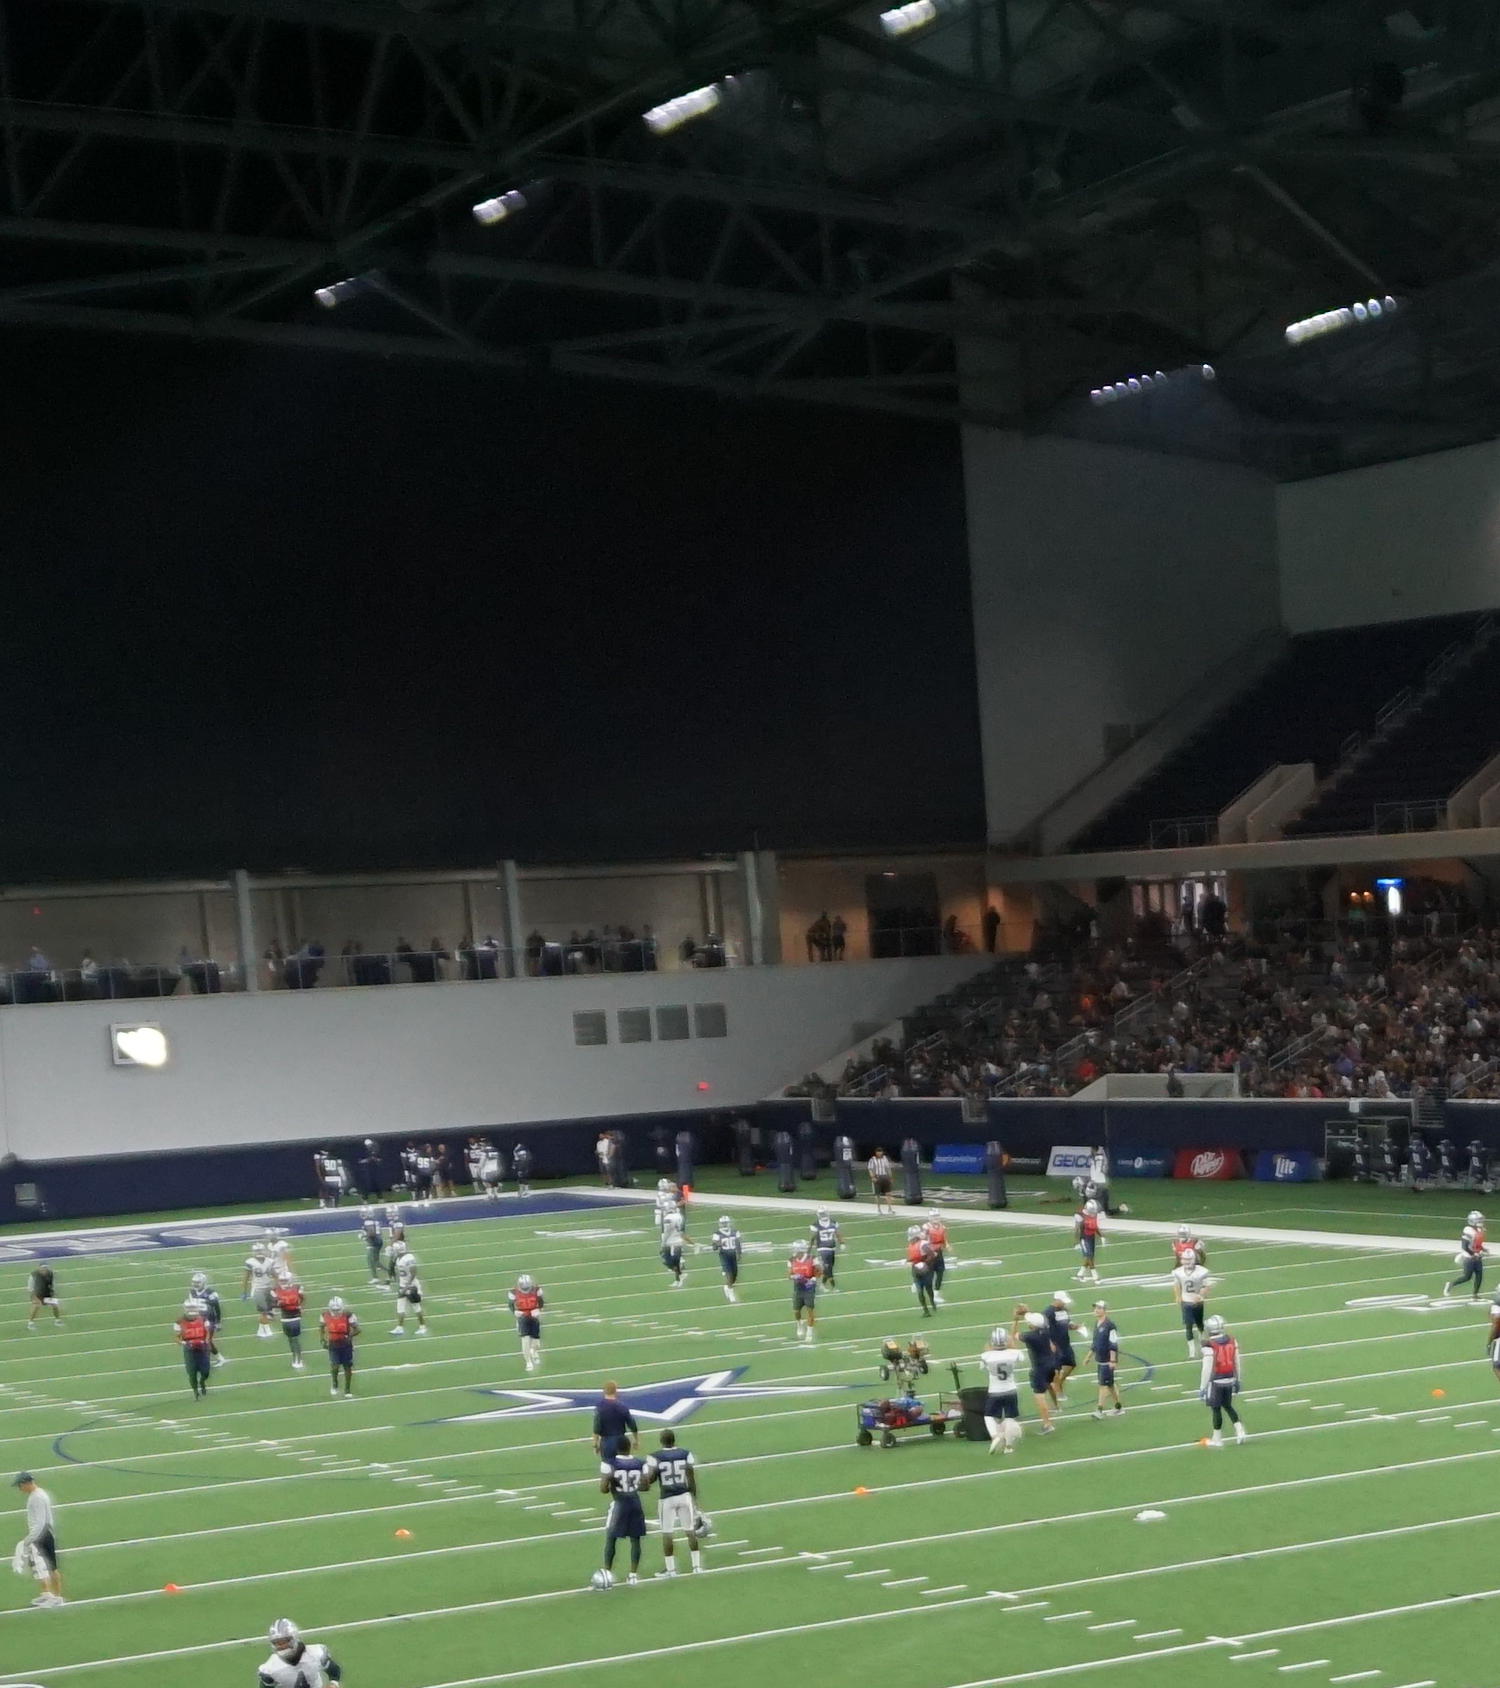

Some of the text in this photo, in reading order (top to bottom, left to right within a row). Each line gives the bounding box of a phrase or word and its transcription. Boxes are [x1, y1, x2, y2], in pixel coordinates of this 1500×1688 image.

[1275, 1158, 1297, 1177] Lite
[819, 1229, 836, 1242] 57
[1185, 1280, 1195, 1294] 2
[997, 1363, 1008, 1381] 5
[614, 1469, 642, 1493] 33
[659, 1459, 686, 1486] 25
